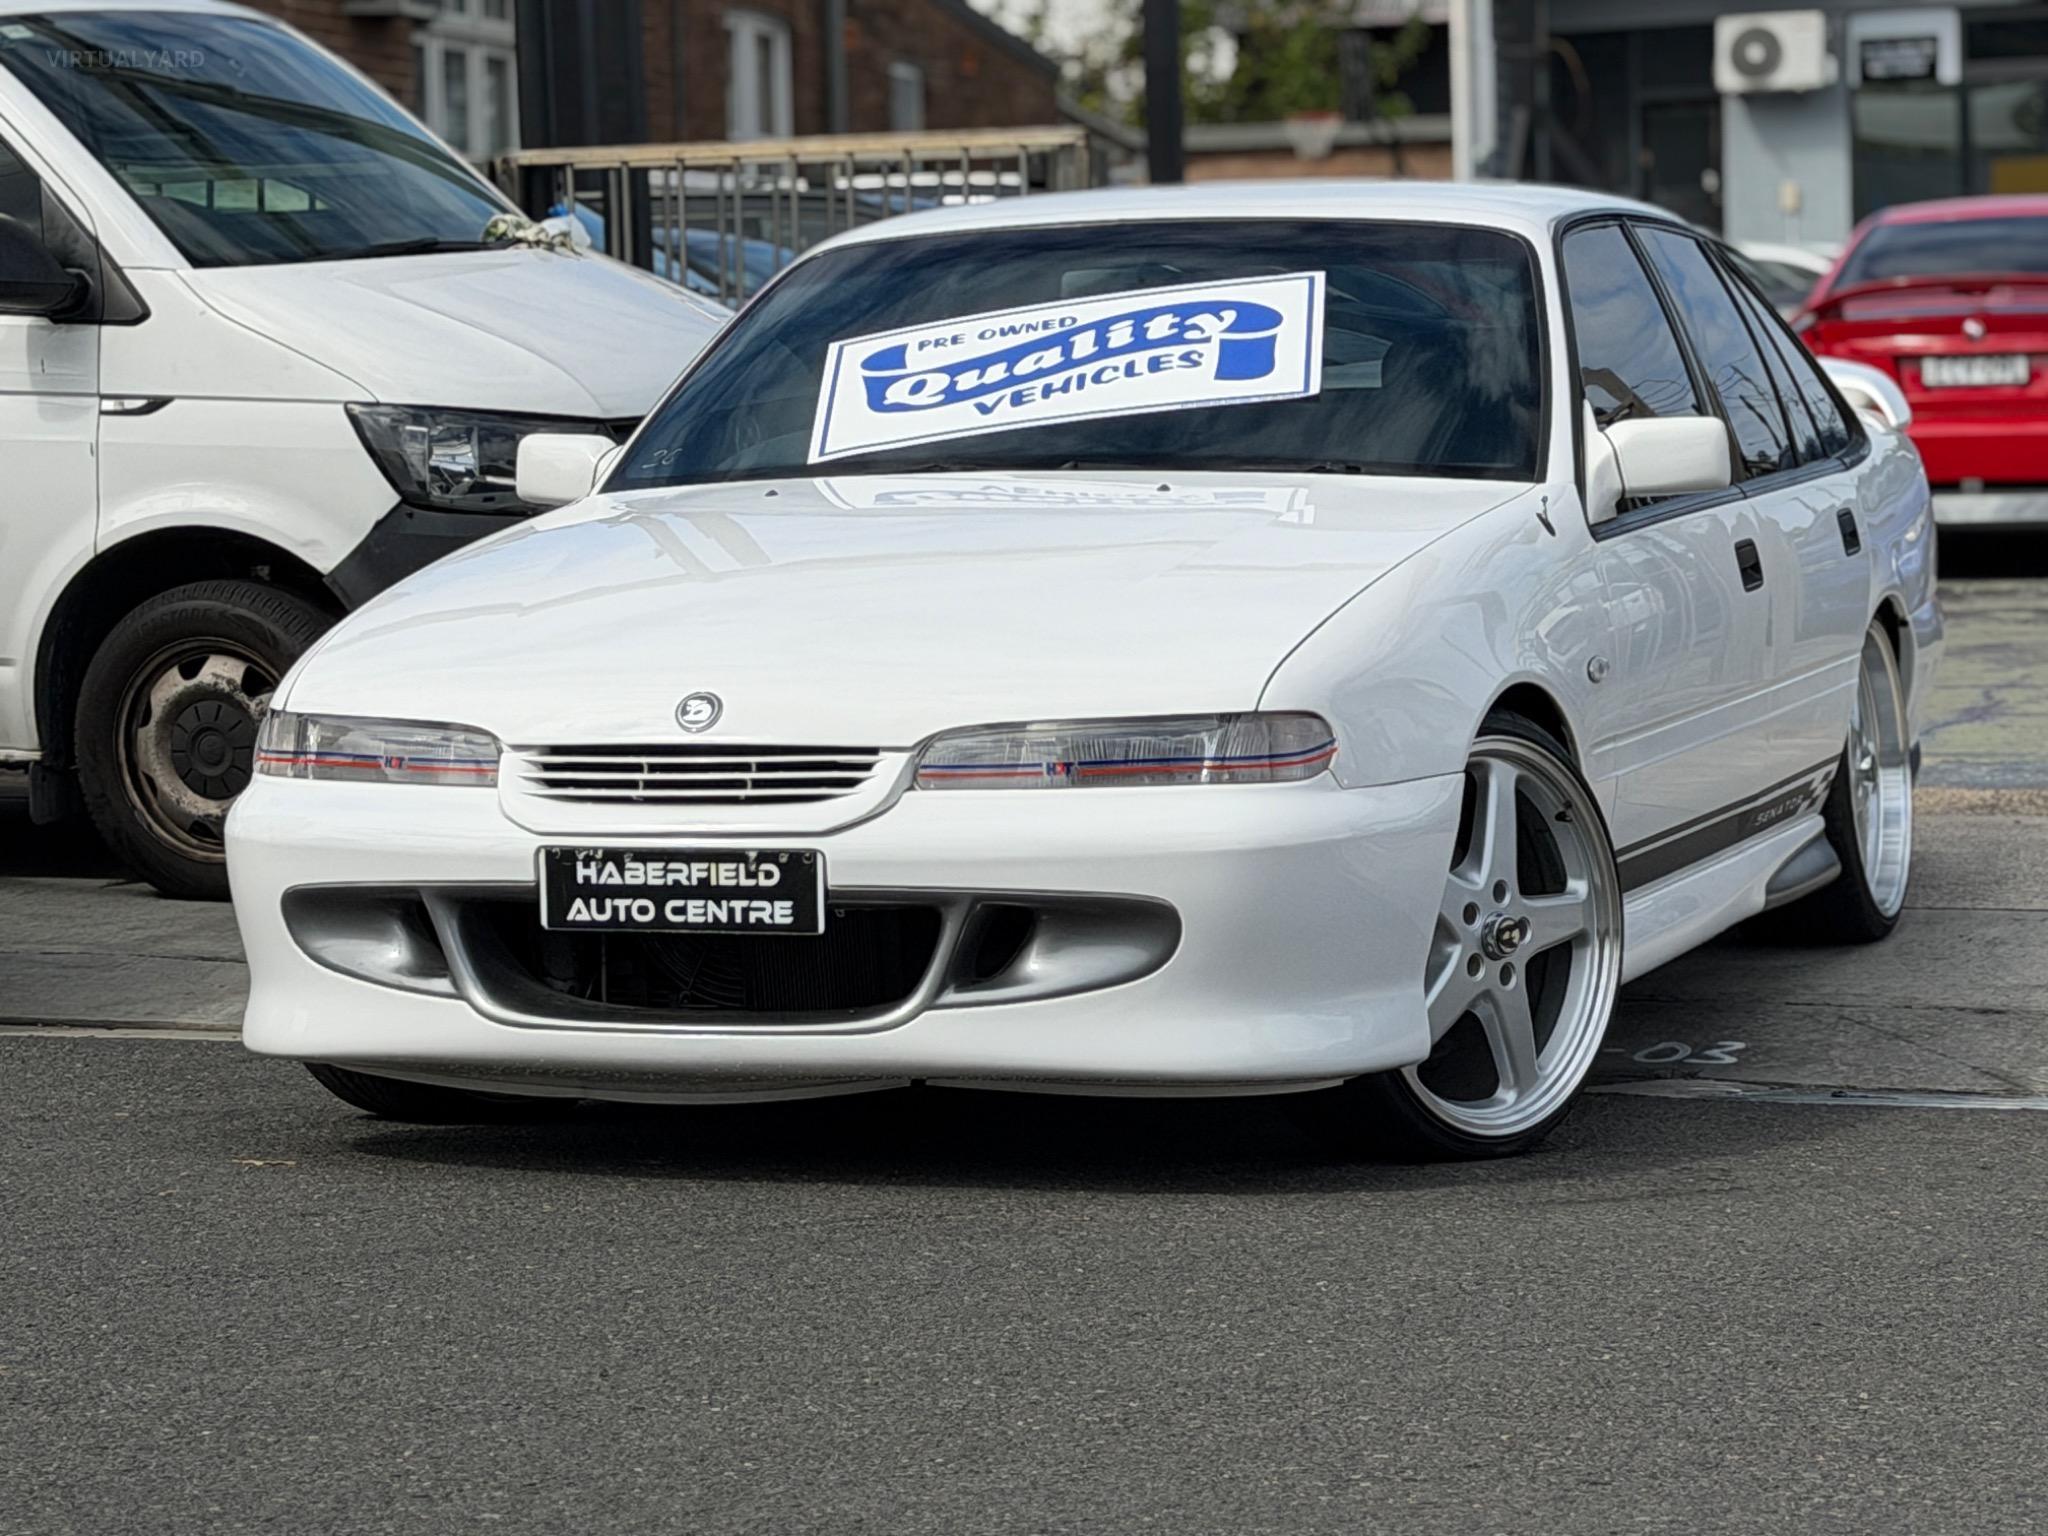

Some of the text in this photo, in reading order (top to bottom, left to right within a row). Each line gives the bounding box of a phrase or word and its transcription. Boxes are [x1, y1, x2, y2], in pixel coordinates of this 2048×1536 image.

[917, 315, 1079, 352] PRE OWNED
[883, 308, 1239, 408] Quality
[973, 350, 1205, 417] VEHICLES
[575, 861, 781, 886] HABERFIELD
[566, 898, 794, 924] AUTO CENTRE
